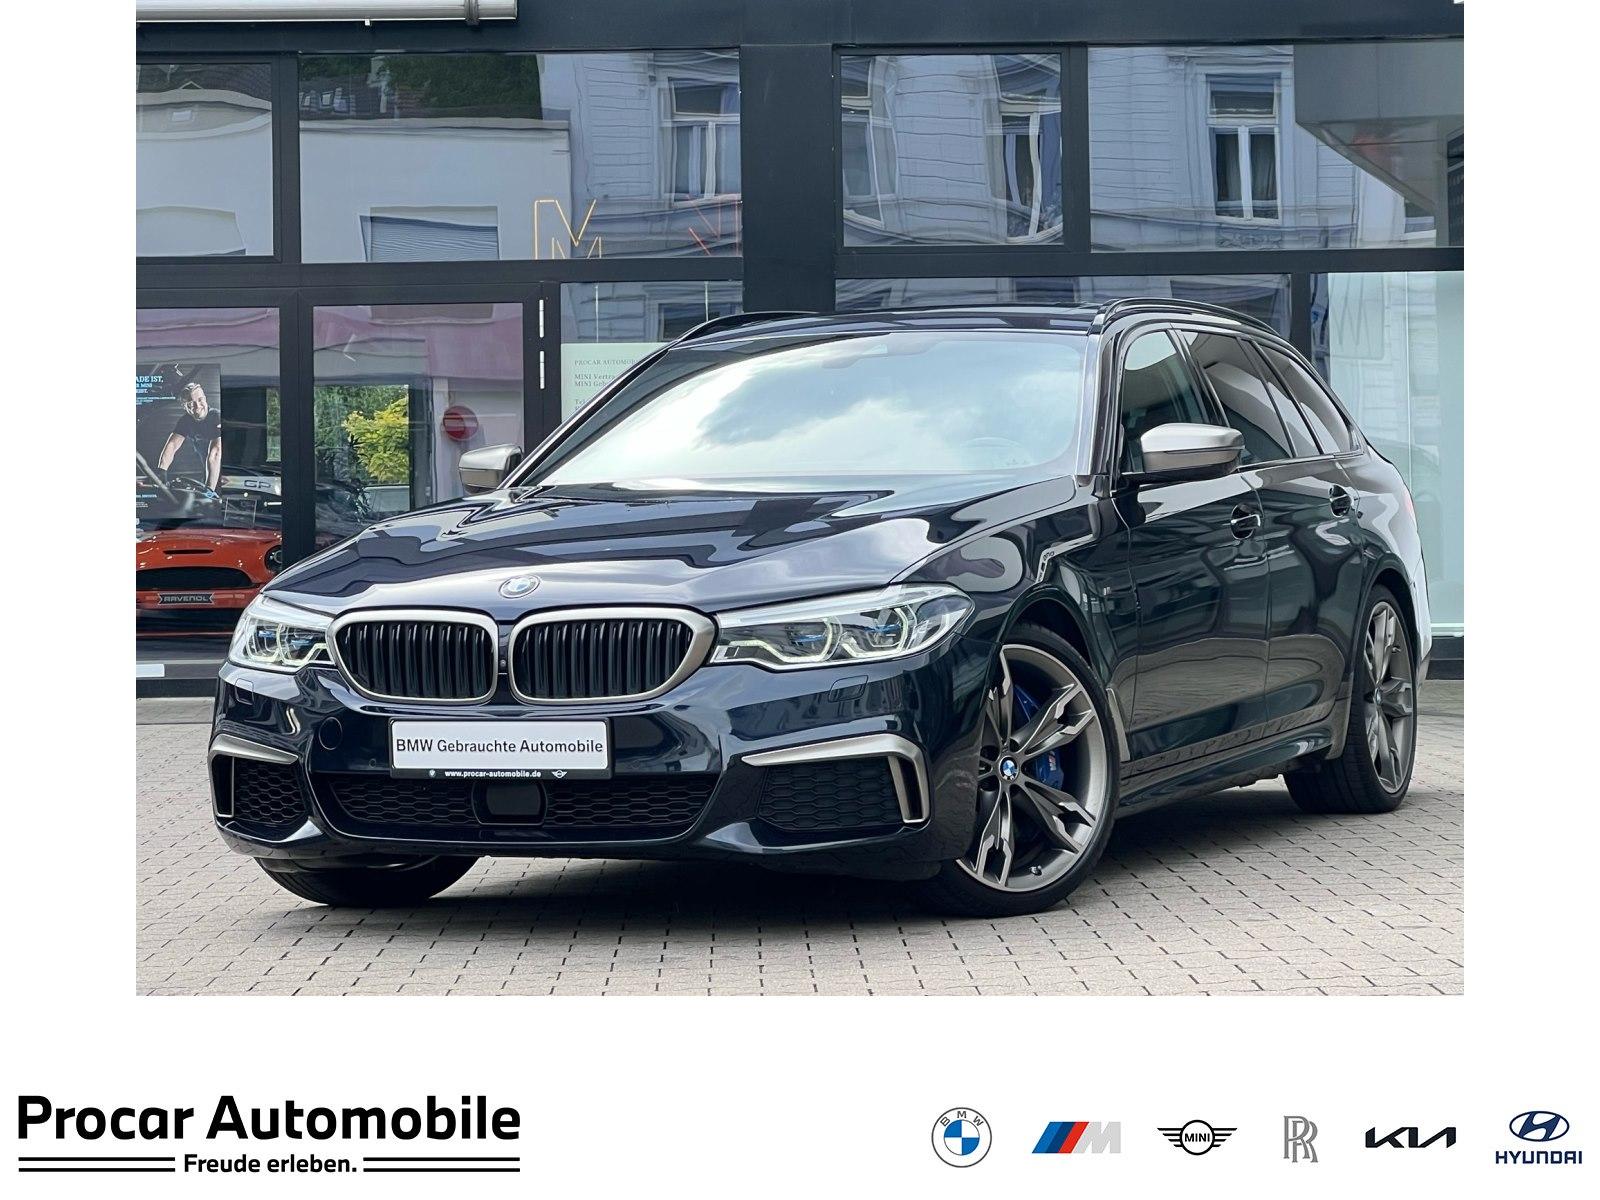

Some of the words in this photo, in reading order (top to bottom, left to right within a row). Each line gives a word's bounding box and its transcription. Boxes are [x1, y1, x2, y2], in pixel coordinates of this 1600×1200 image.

[163, 594, 207, 602] RAVENOL
[396, 738, 433, 752] BMW
[437, 739, 516, 752] Gebrauchte
[520, 739, 603, 752] Automobile
[444, 770, 542, 778] www.procar-automobile.de
